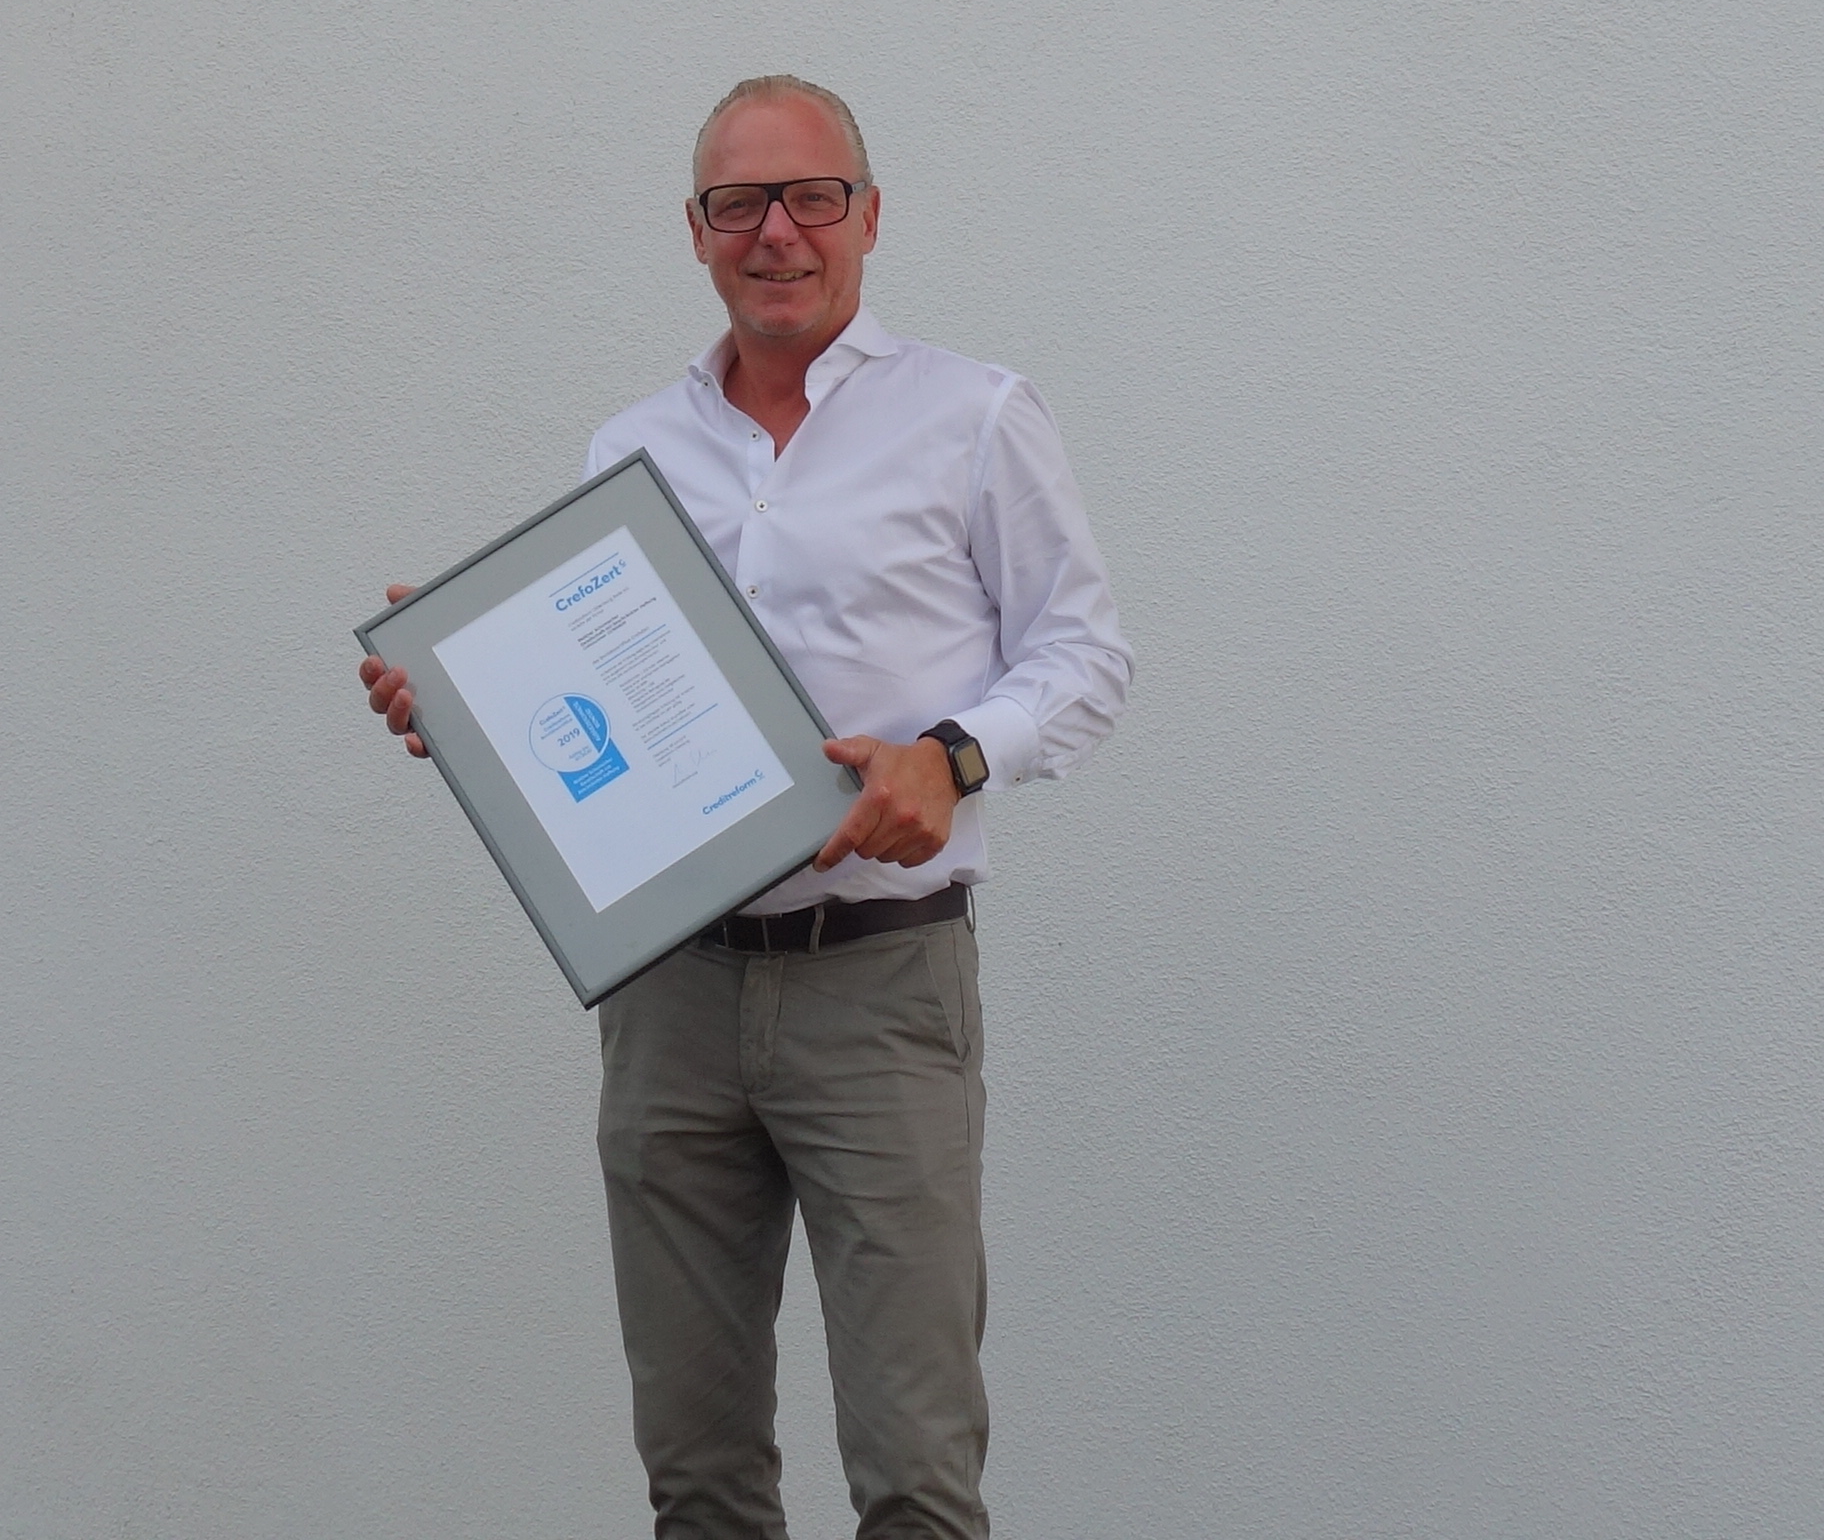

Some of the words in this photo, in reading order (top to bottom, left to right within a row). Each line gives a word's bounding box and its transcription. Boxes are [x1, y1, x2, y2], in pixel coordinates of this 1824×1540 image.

[555, 565, 622, 612] CrefoZert
[557, 727, 581, 747] 2019
[702, 778, 757, 816] Creditreform
